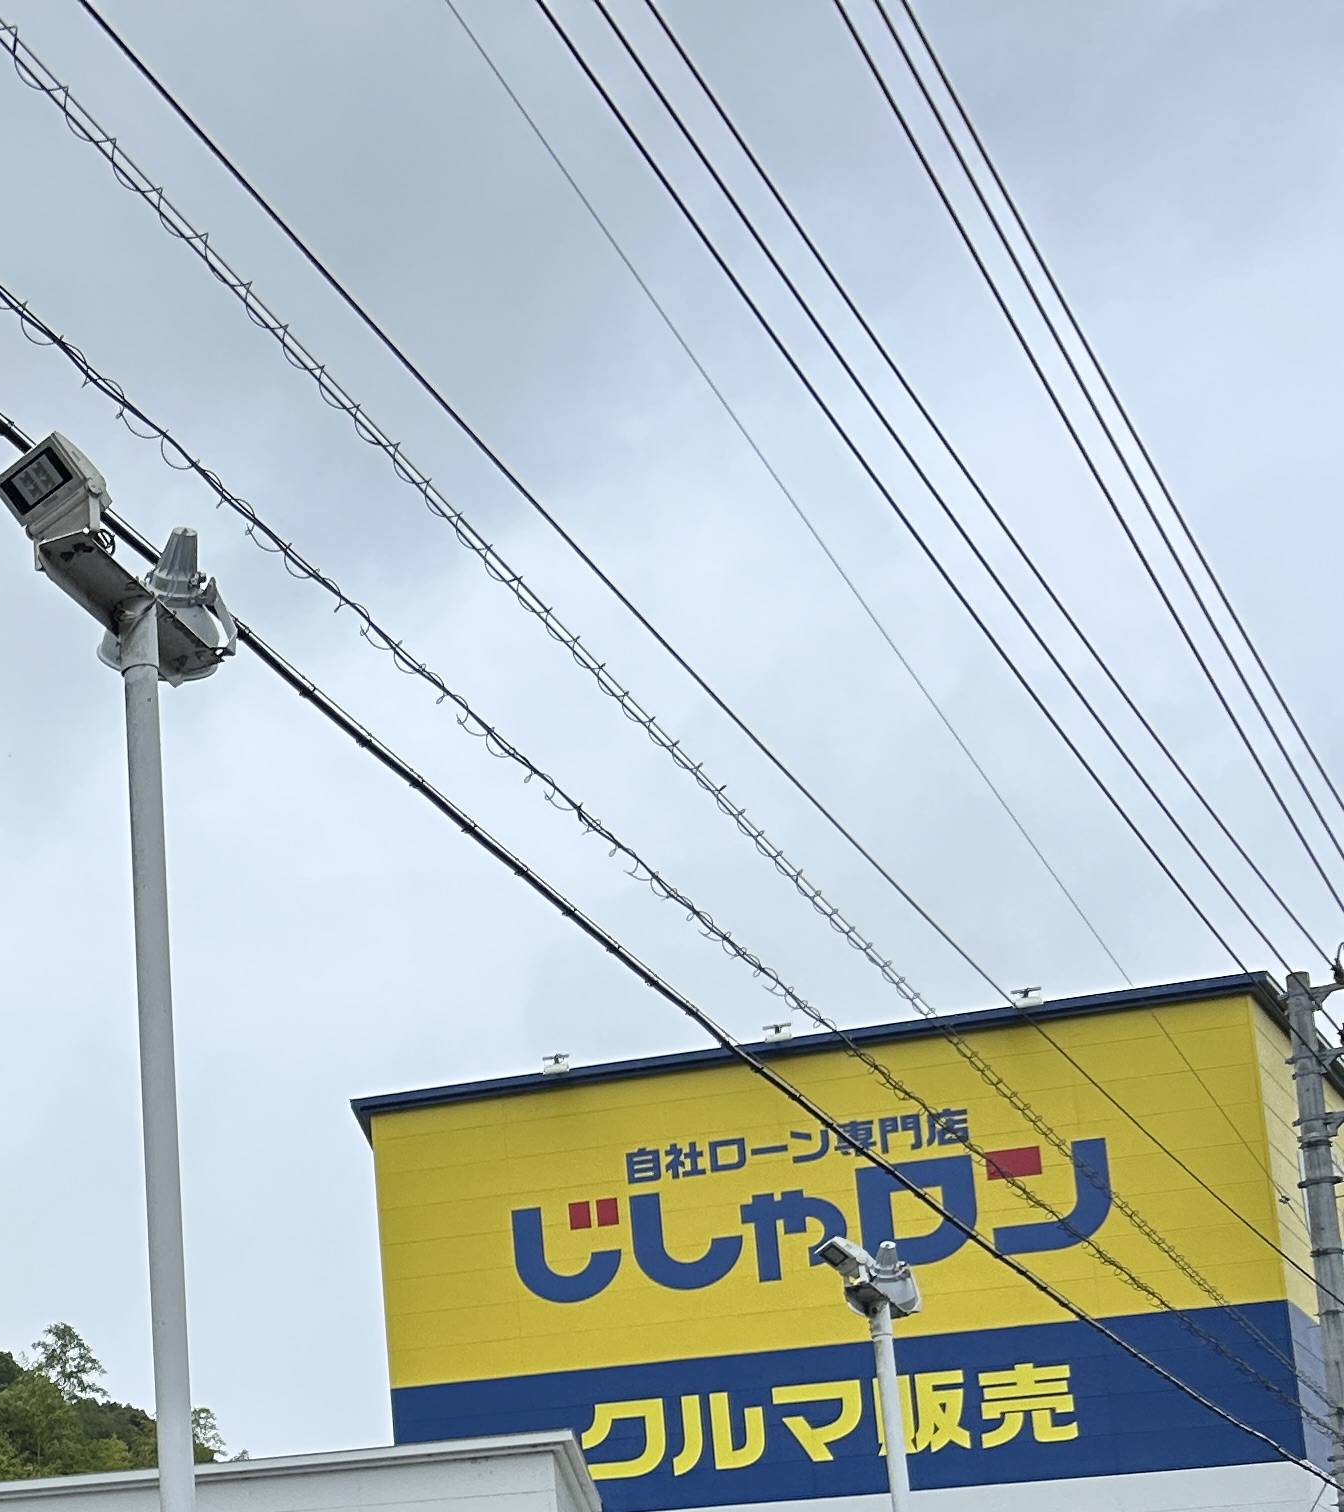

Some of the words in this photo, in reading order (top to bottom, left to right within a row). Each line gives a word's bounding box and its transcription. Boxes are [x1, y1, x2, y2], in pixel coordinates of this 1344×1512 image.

[625, 1108, 970, 1185] 自社ローン専門店
[582, 1363, 1079, 1481] クルマ販売
